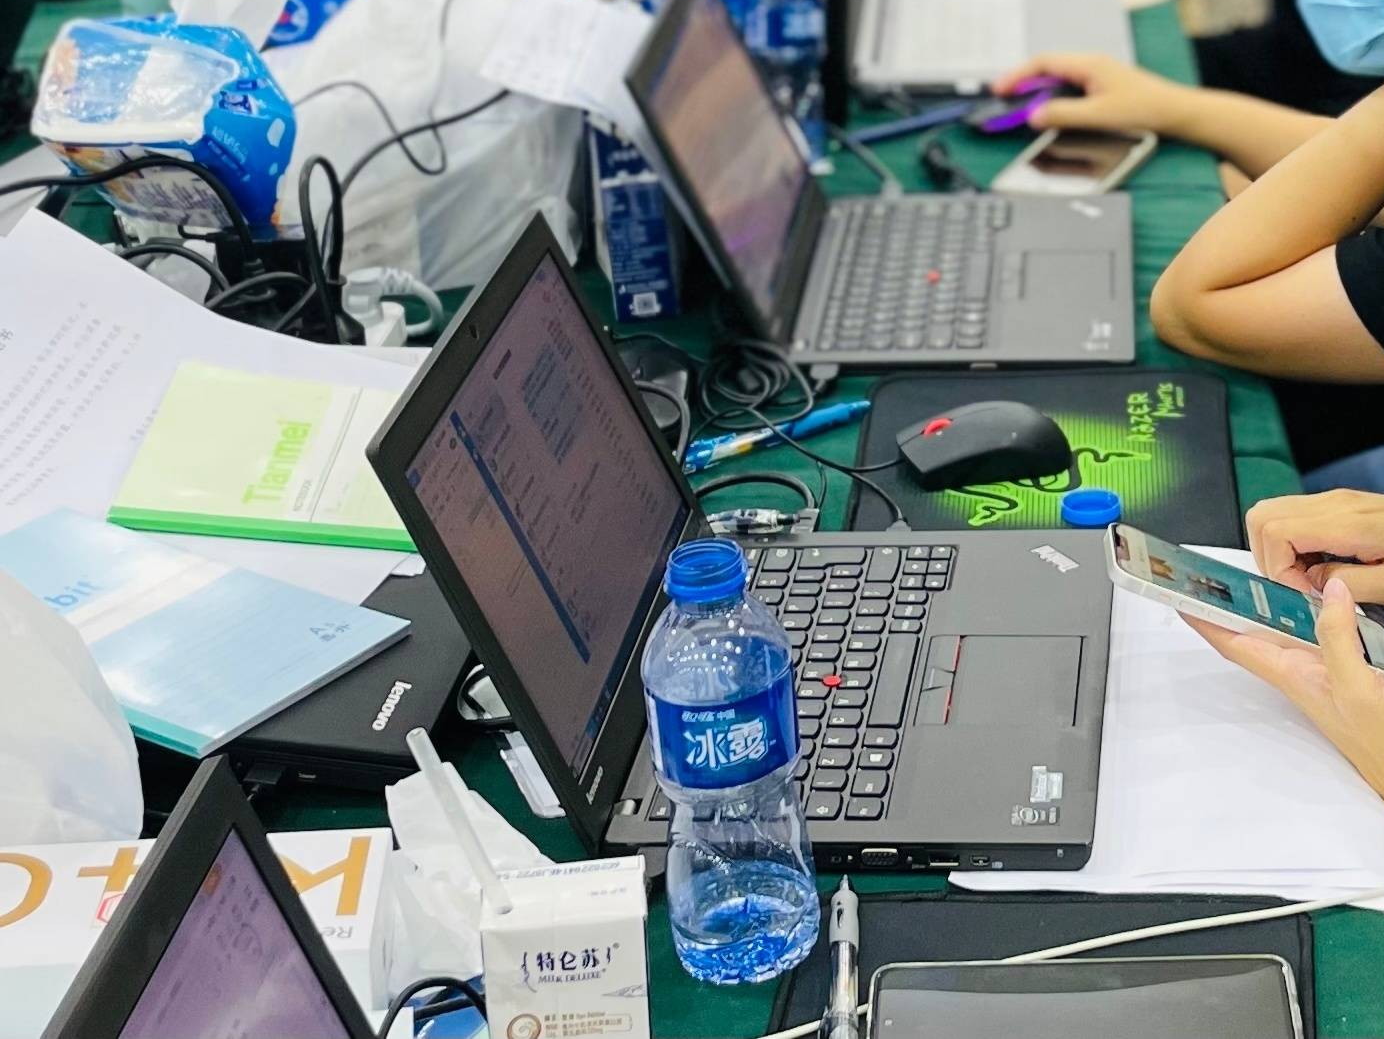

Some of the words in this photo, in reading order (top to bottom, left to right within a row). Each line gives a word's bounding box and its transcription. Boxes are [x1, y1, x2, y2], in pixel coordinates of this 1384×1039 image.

[372, 680, 412, 731] lenovo
[682, 717, 768, 770] 冰露
[536, 948, 600, 972] 特仑苏
